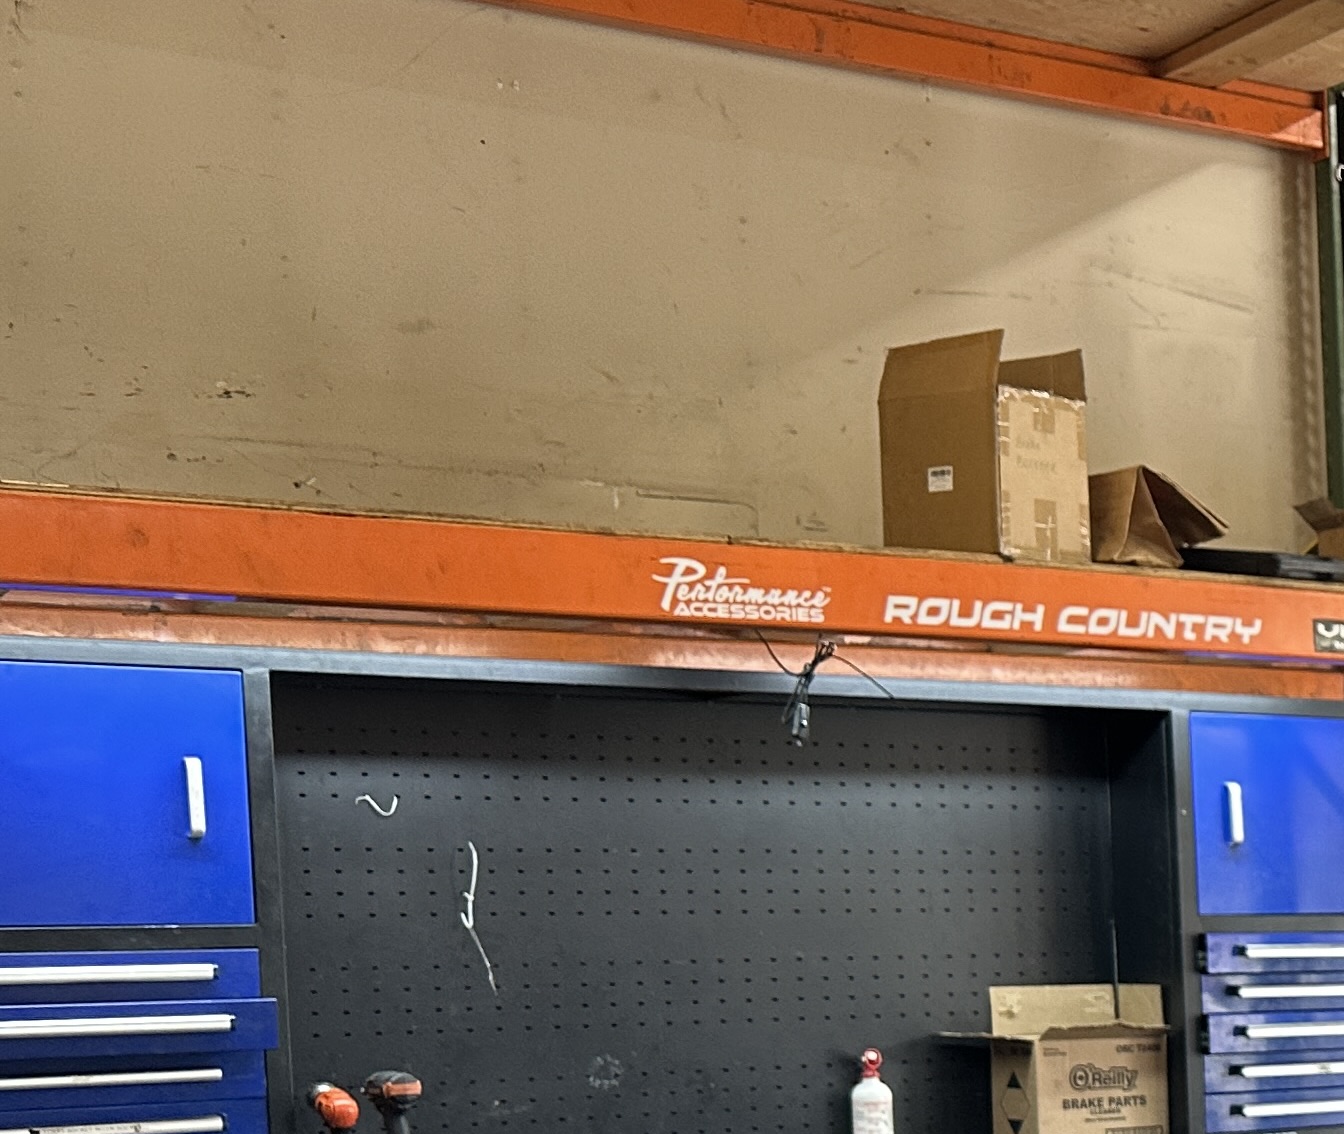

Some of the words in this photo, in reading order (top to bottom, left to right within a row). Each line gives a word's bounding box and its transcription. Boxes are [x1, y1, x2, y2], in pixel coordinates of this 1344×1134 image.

[652, 557, 831, 612] Performance
[673, 601, 825, 623] ACCESSORIES
[883, 595, 1046, 632] ROUGH
[1056, 605, 1262, 644] COUNTRY
[1069, 1063, 1138, 1091] O'Reilly
[1062, 1097, 1104, 1110] BRAKE
[1108, 1094, 1147, 1108] PARTS
